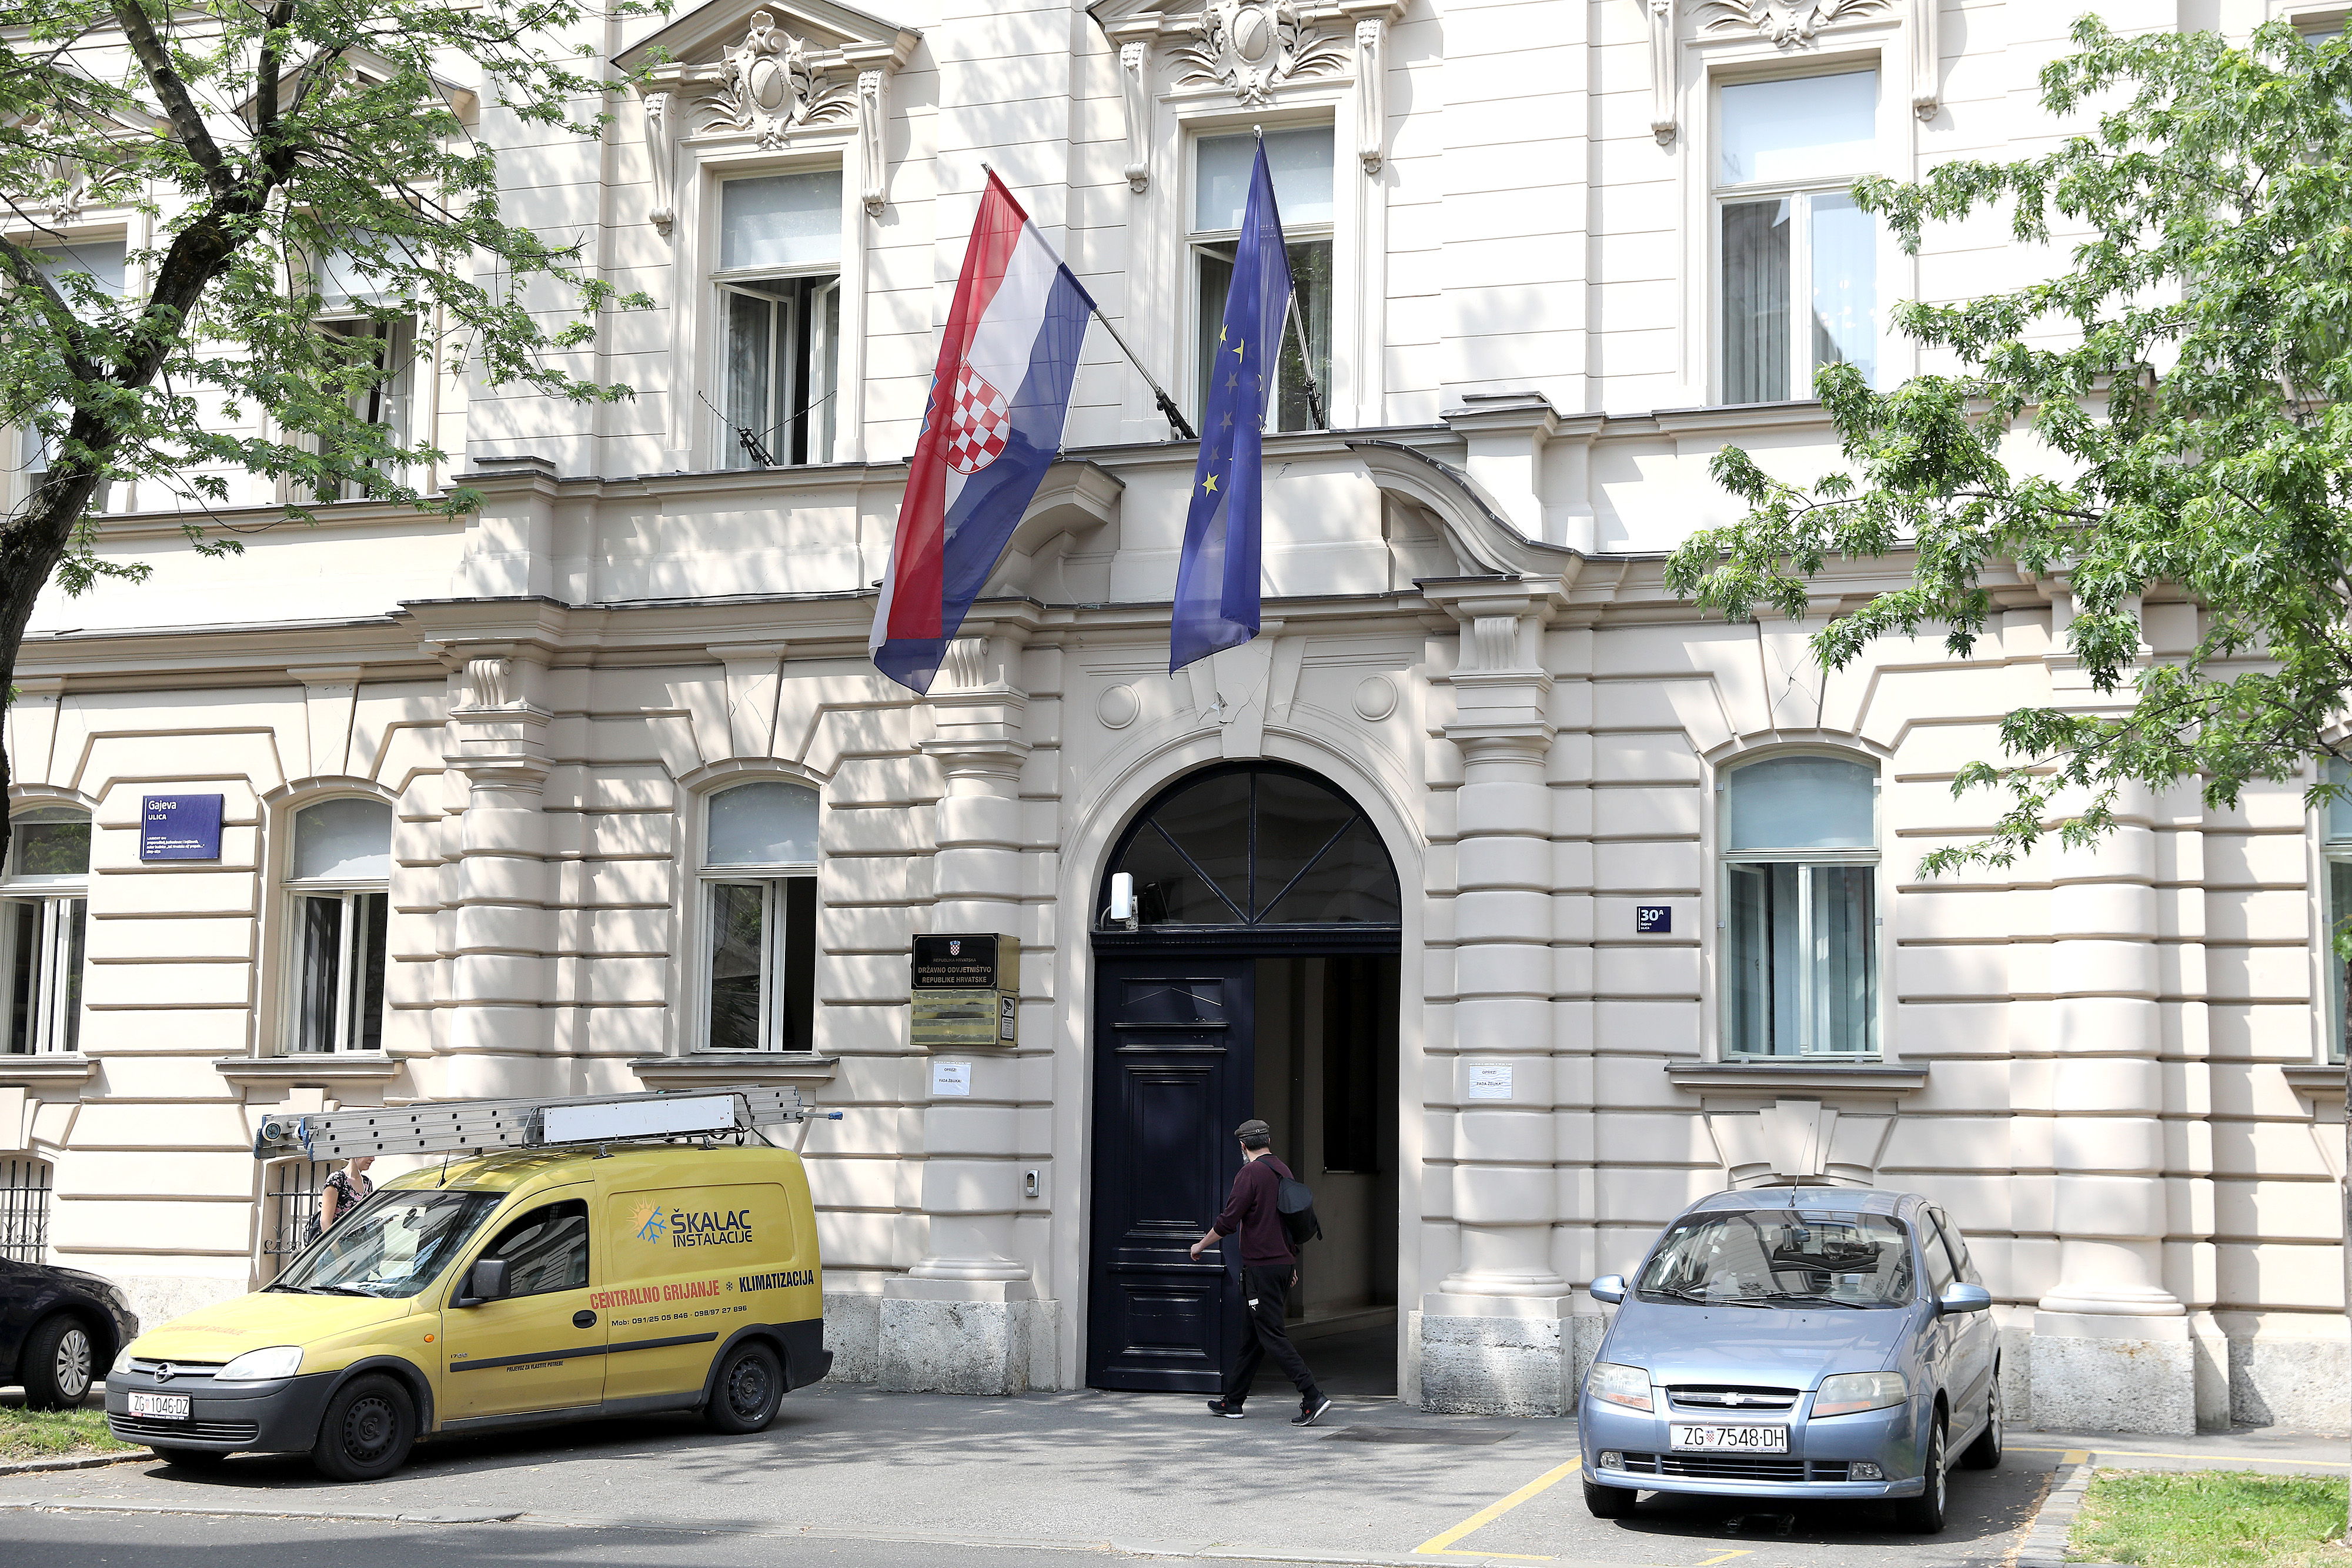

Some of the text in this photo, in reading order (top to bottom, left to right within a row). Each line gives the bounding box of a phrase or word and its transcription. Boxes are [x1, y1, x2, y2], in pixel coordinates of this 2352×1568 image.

[148, 800, 177, 812] Gajeva
[948, 965, 991, 973] ODVJETNIŠTVO
[670, 1208, 751, 1233] ŠKALAC
[673, 1230, 753, 1248] INSTALACIJE
[590, 1269, 814, 1309] CENTRALNO GRIJANJE KLIMATIZACIJA
[632, 1316, 659, 1325] 091/25
[694, 1308, 720, 1317] 098/97
[135, 1396, 144, 1411] ZG
[1684, 1427, 1704, 1445] ZG
